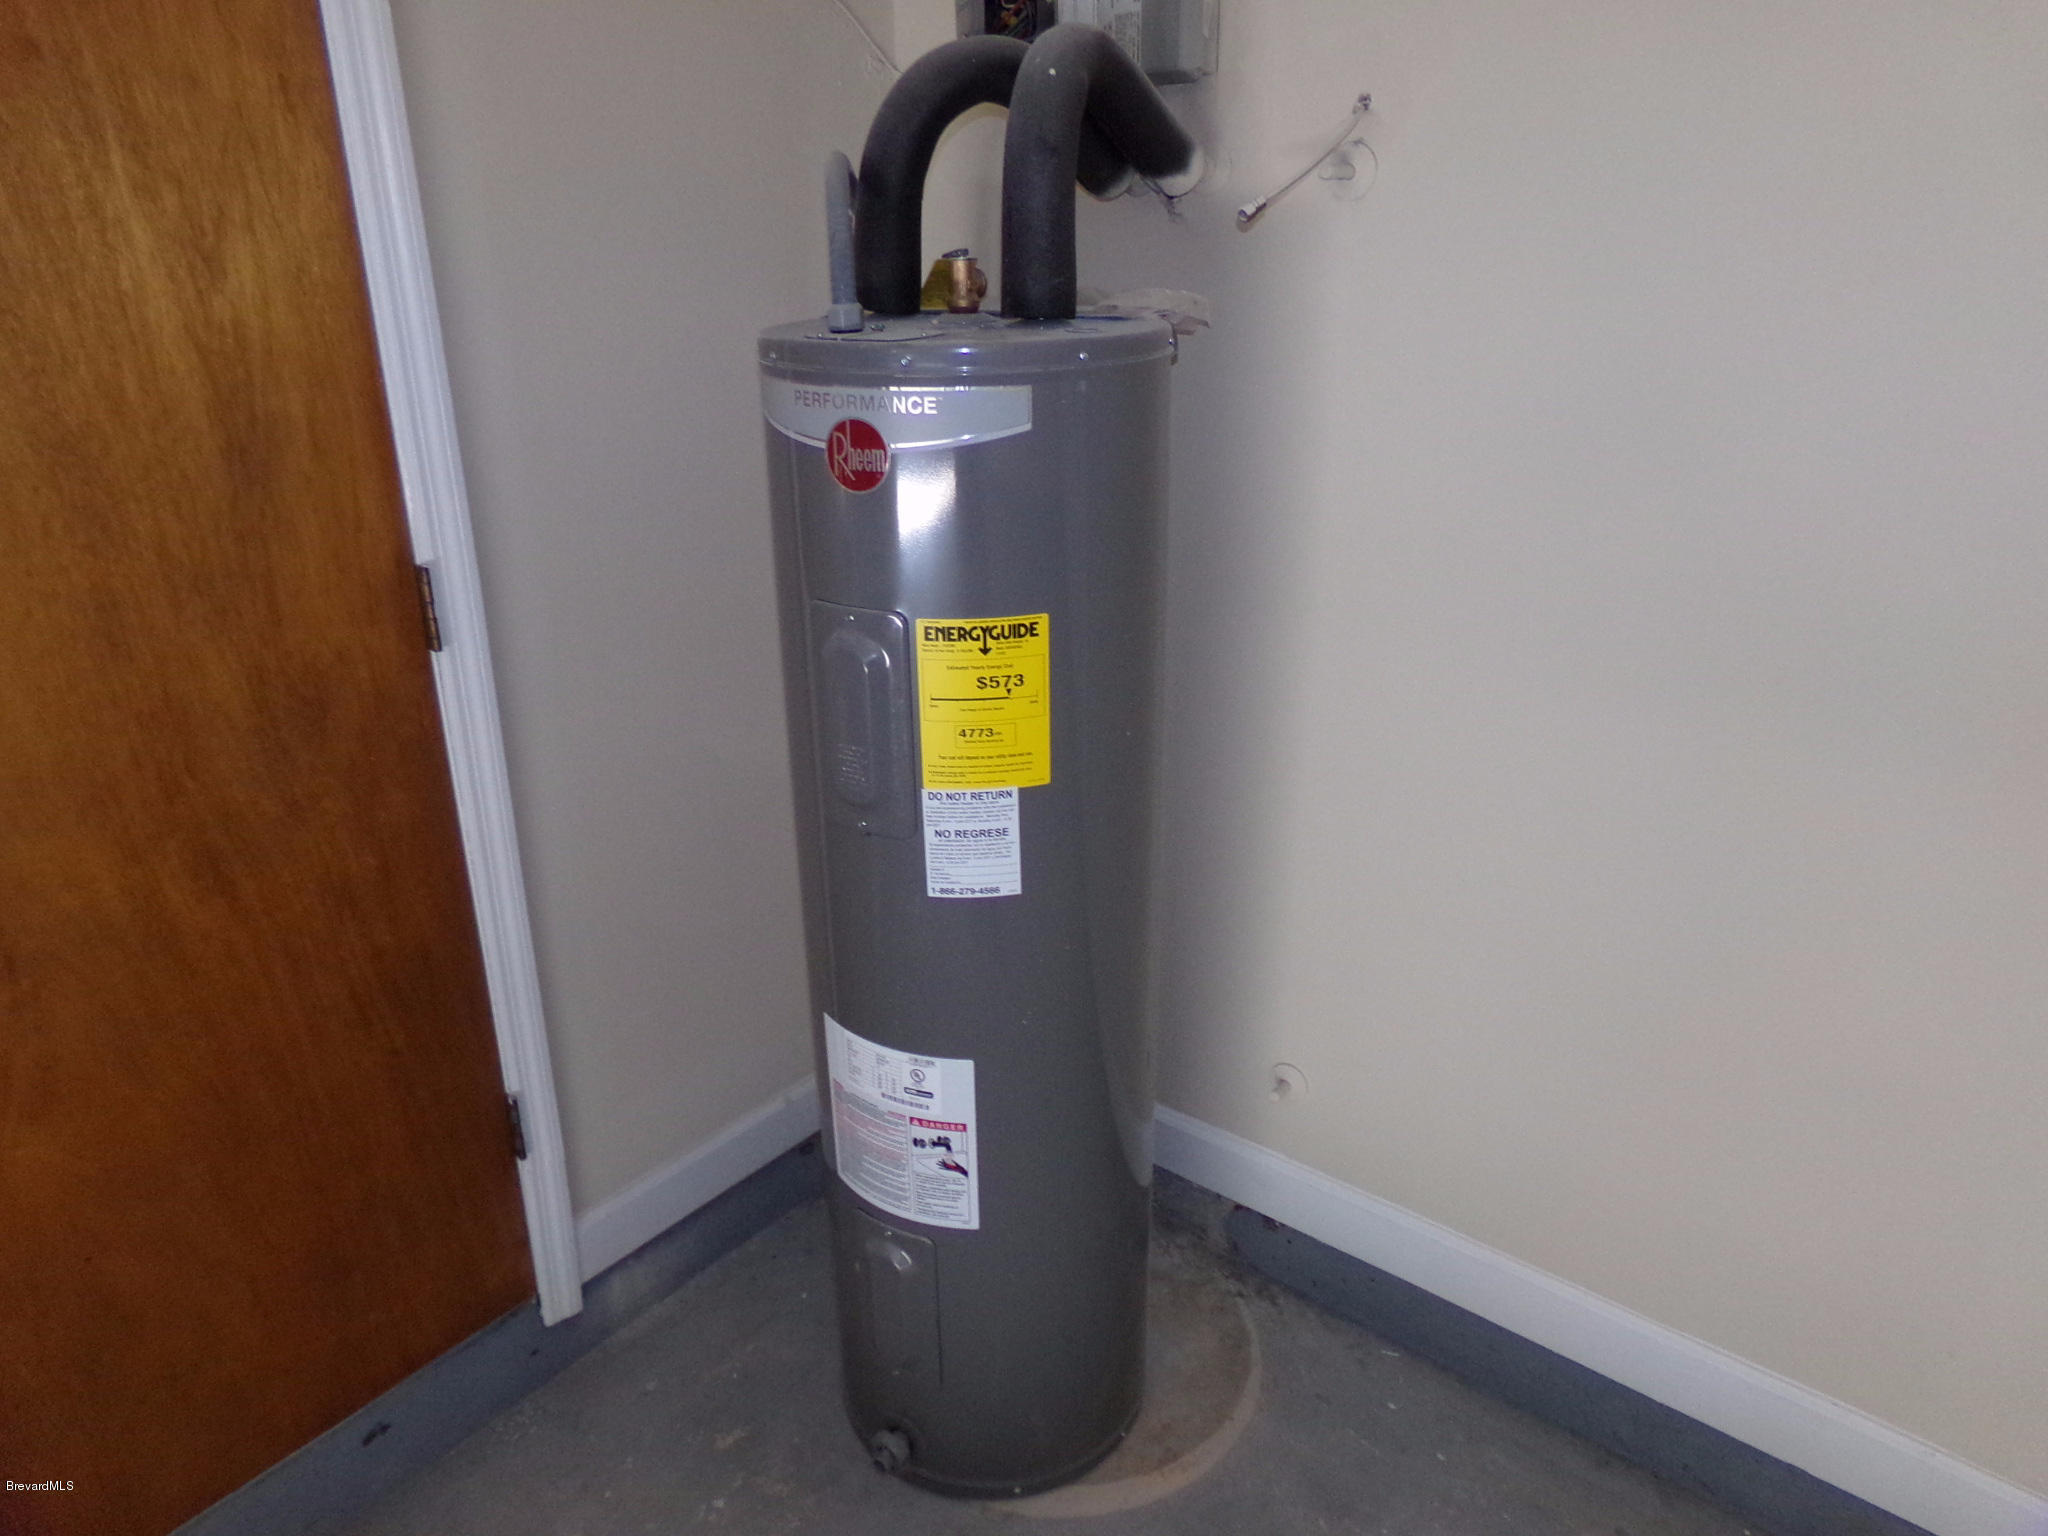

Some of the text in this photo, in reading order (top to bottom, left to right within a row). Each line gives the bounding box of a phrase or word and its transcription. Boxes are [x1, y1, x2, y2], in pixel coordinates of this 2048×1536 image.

[793, 389, 938, 415] PERFORMANCE
[832, 419, 887, 481] Rheem
[923, 621, 1040, 643] ENERGYGUIDE
[975, 673, 1025, 690] $573
[958, 727, 994, 738] 4773
[928, 790, 1014, 801] DO NOT RETURN
[934, 827, 1009, 839] NO REGRESE
